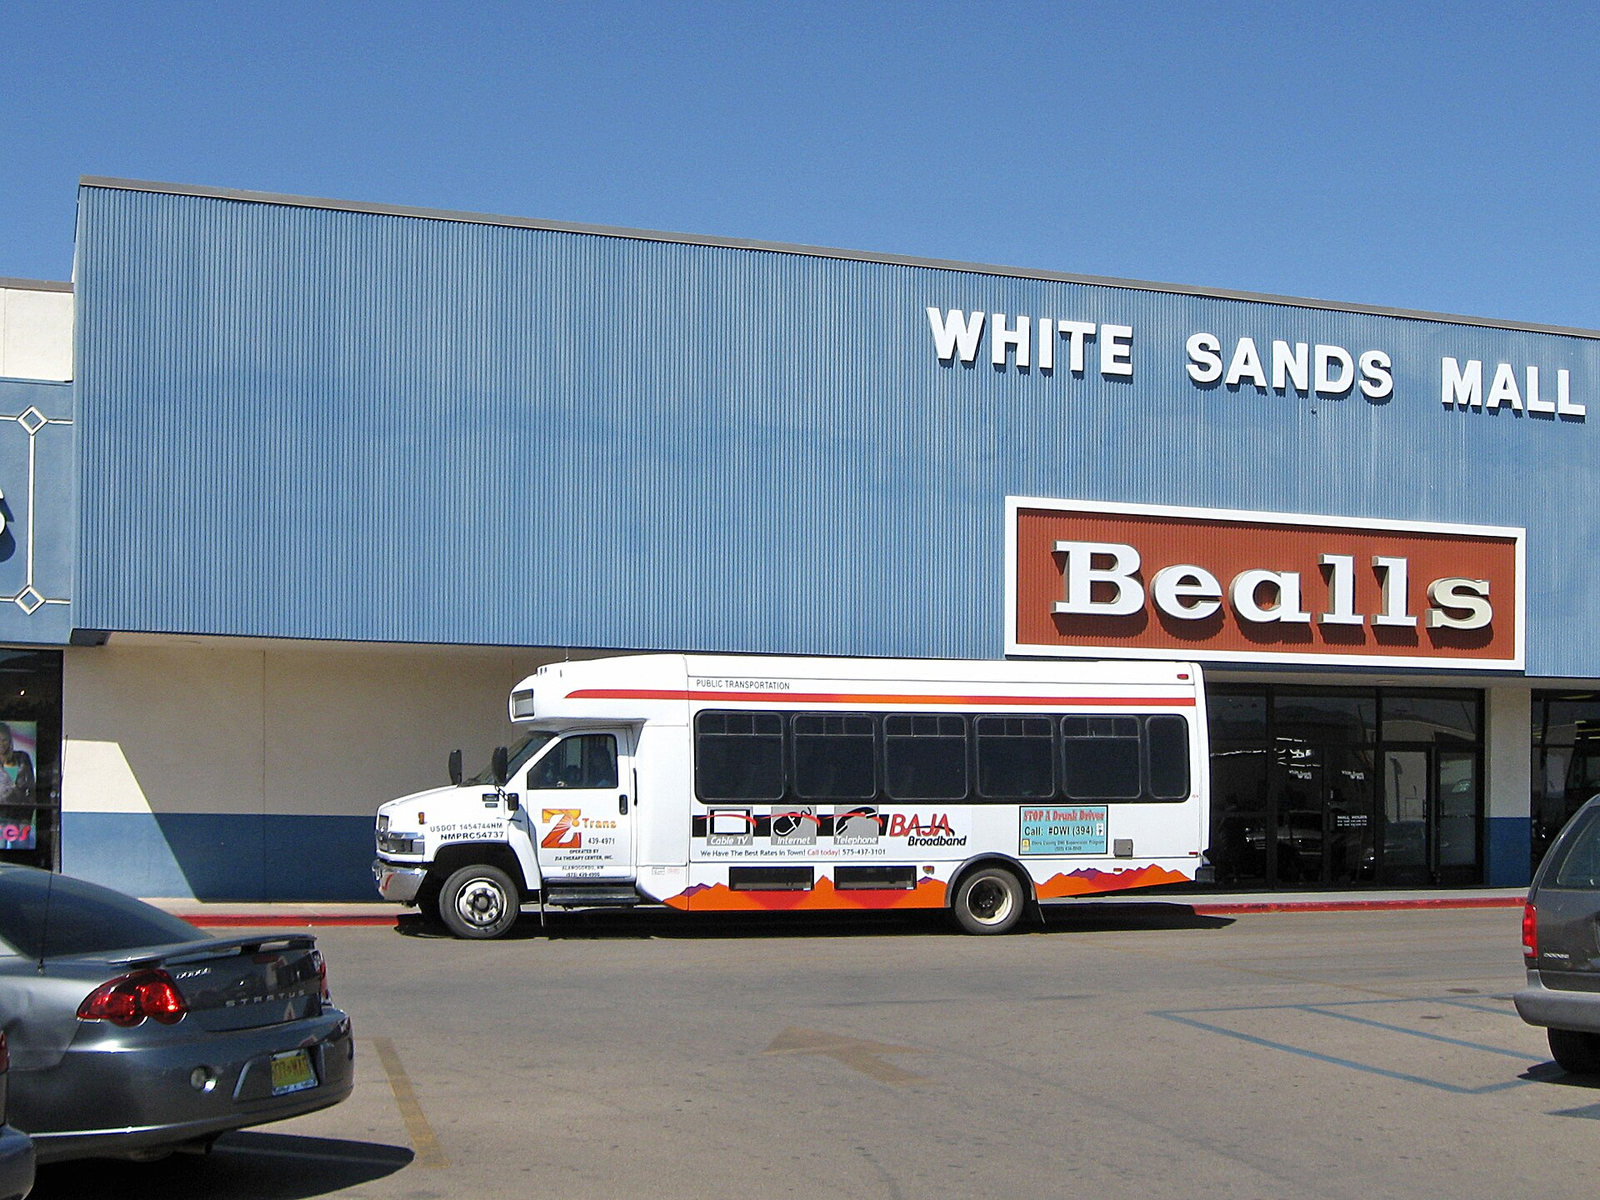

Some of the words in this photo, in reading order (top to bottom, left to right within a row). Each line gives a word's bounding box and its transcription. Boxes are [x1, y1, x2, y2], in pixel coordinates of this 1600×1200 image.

[926, 306, 1134, 377] WHITE
[1185, 333, 1394, 399] SANDS
[1441, 356, 1587, 417] MALL
[1051, 539, 1494, 630] Bealls
[696, 678, 723, 688] PUBLIC
[725, 679, 790, 690] TRANSPORTATION
[1023, 810, 1044, 822] STOP
[1046, 810, 1051, 822] A
[1052, 809, 1078, 822] Drunk
[1079, 809, 1105, 821] Driver
[429, 823, 457, 833] USDOT
[581, 817, 617, 829] Trans
[889, 813, 951, 837] BAJA
[0, 824, 31, 842] es
[440, 831, 504, 841] NMPRC54737
[1024, 826, 1044, 836] Call:
[1048, 825, 1070, 836] #DWI
[1072, 825, 1094, 837] (394)
[710, 836, 734, 845] Cable
[737, 836, 748, 845] TV
[776, 835, 811, 845] Internet
[836, 835, 877, 846] Telephone
[907, 835, 967, 847] Broadband
[731, 849, 743, 857] The
[744, 849, 759, 857] Best
[760, 849, 778, 857] Rates
[787, 848, 806, 857] Town!
[807, 848, 820, 856] Call
[820, 848, 840, 857] today!
